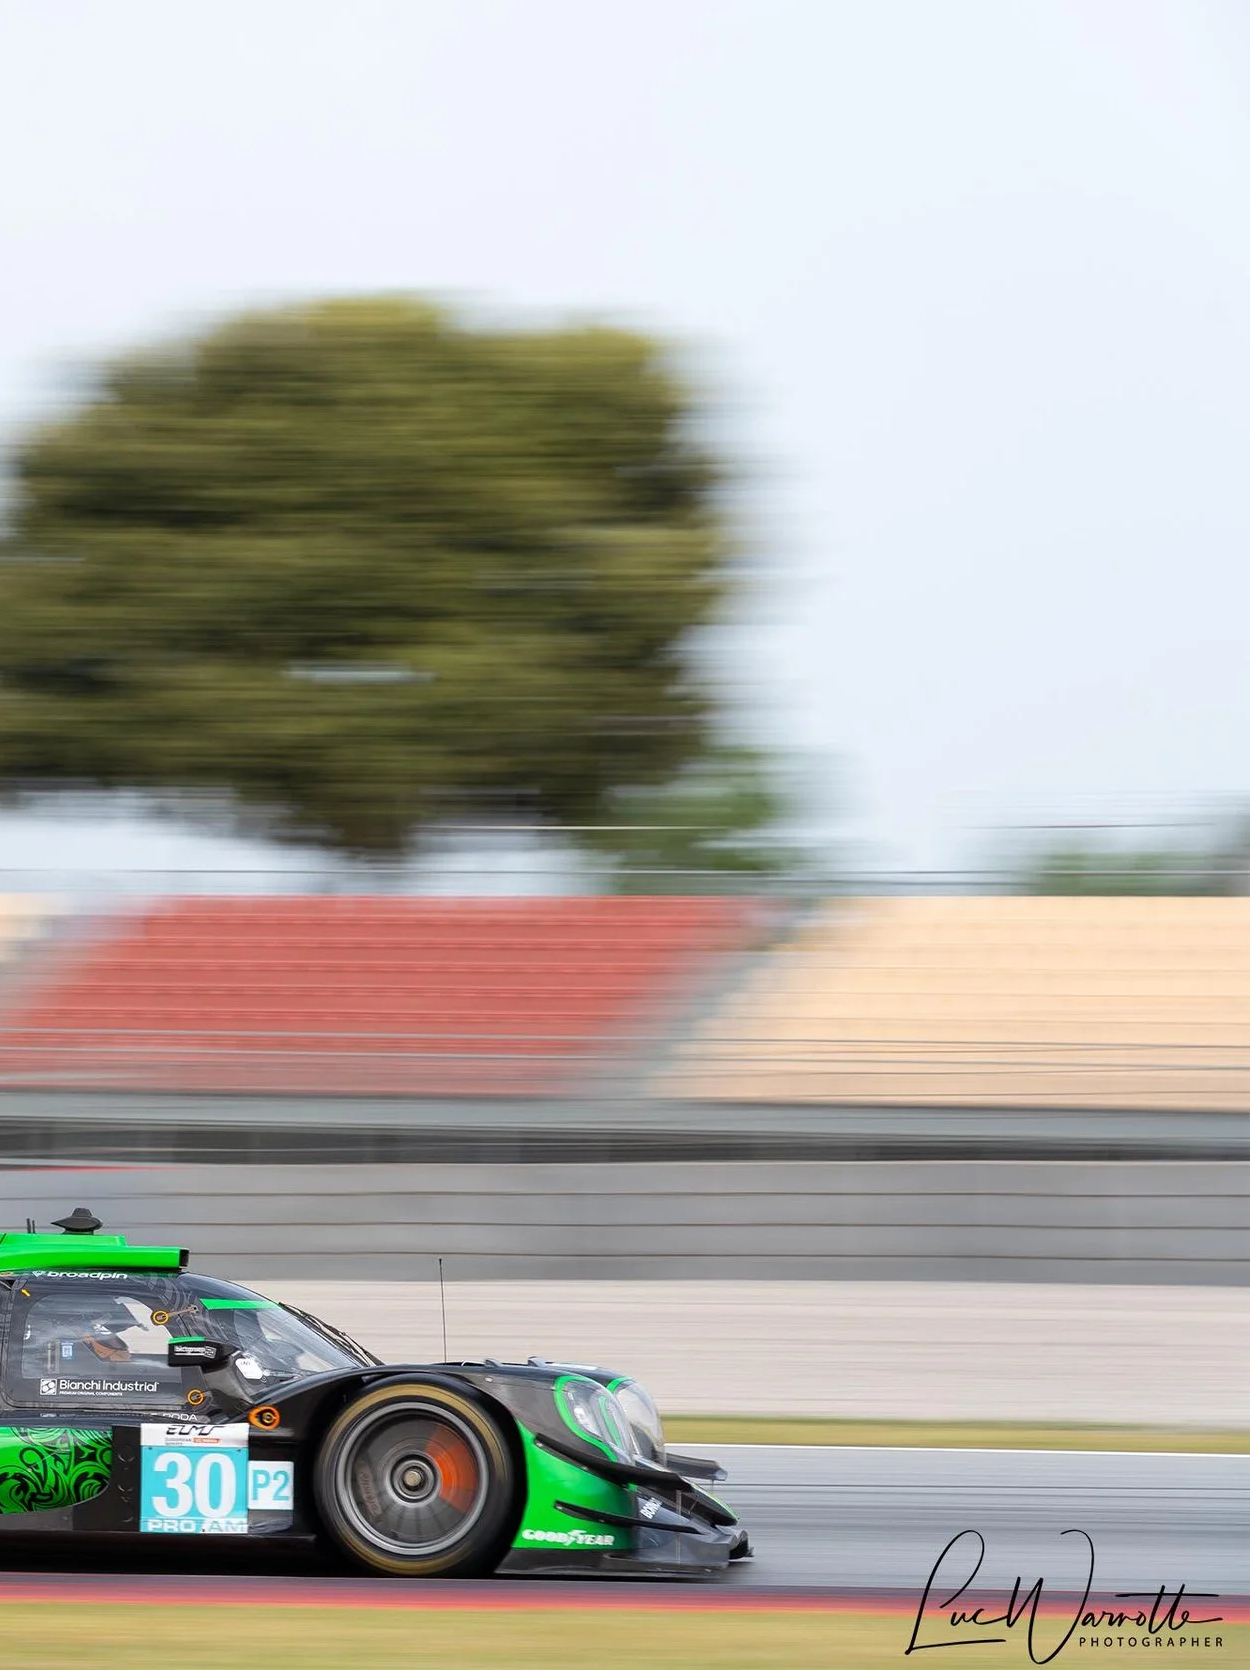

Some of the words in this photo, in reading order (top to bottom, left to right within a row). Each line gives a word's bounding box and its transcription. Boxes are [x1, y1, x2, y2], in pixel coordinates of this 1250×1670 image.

[47, 1271, 128, 1281] broadpin
[59, 1379, 101, 1391] Bianchi
[103, 1380, 159, 1392] Industrial
[152, 1451, 237, 1519] 30
[252, 1469, 291, 1502] P2
[147, 1519, 196, 1532] PRO
[521, 1529, 615, 1546] GOODYEAR
